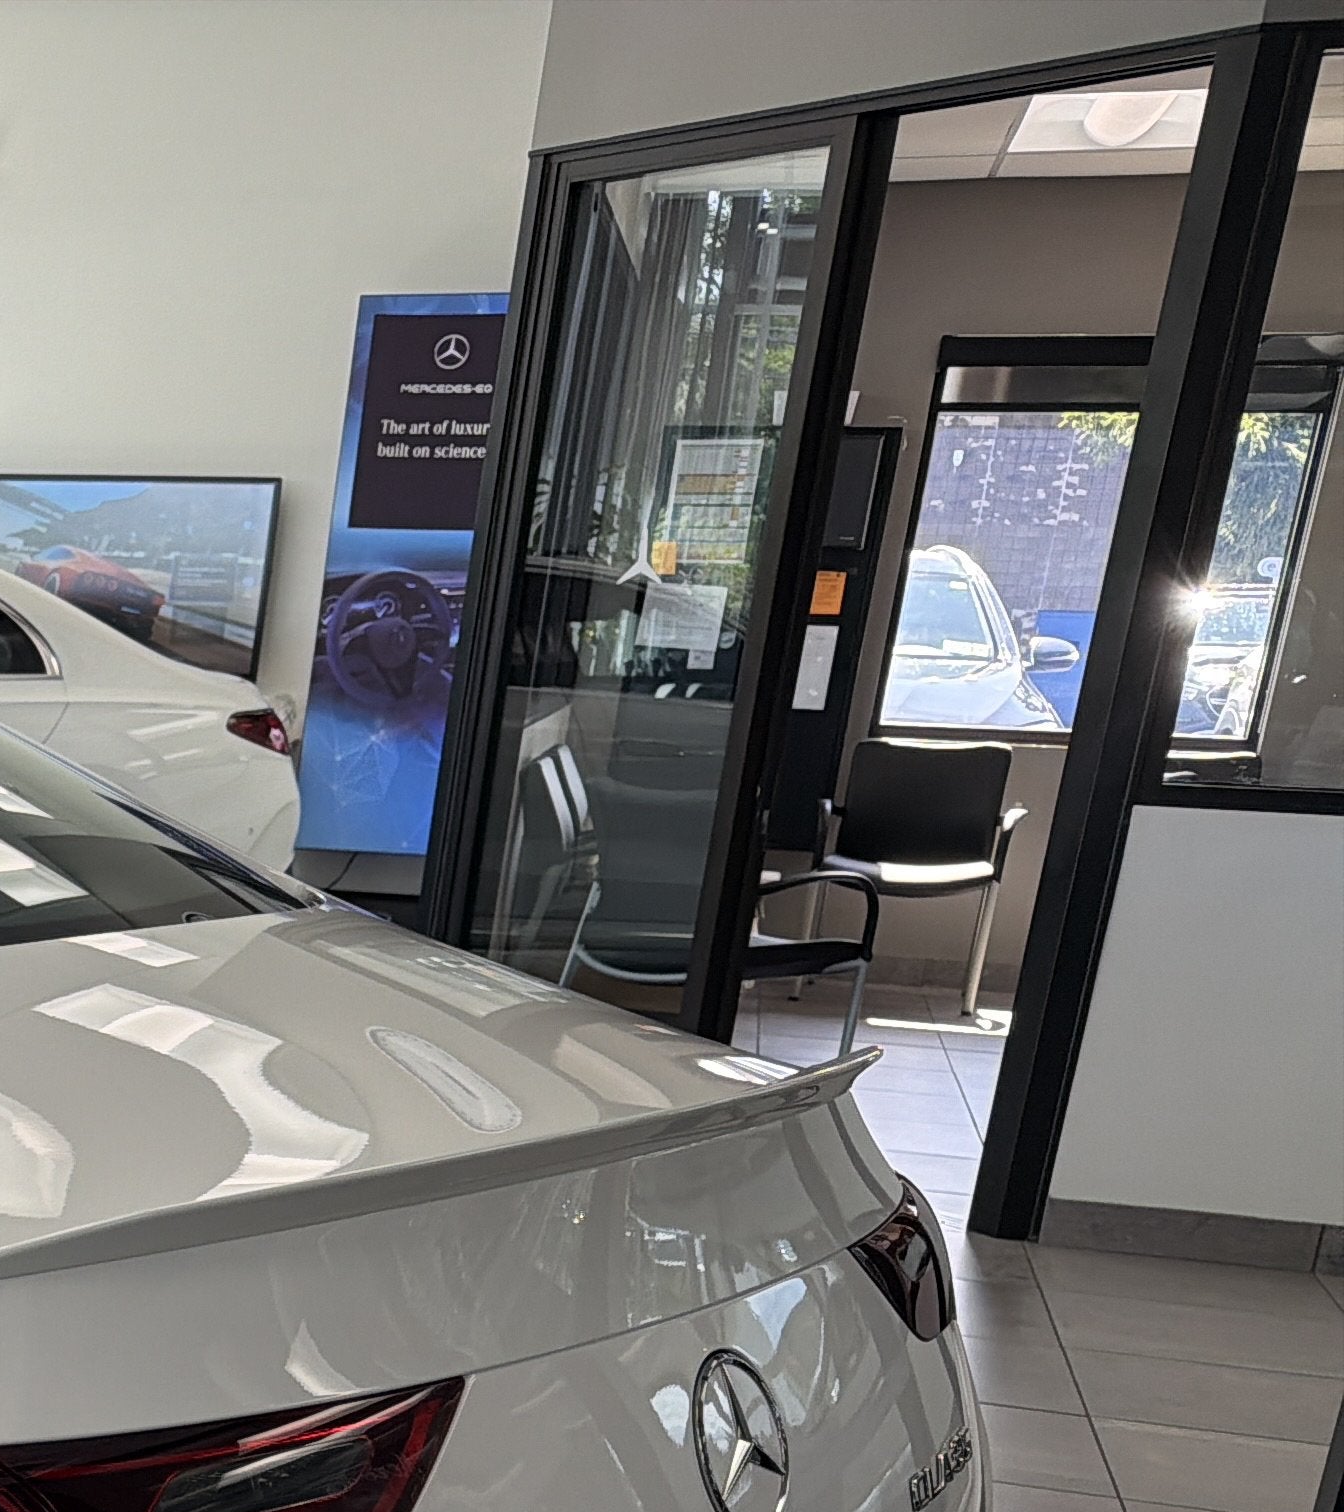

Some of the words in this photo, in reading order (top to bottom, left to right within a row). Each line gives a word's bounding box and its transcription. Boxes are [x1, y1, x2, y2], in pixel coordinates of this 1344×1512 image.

[380, 418, 407, 435] The
[408, 421, 431, 436] art
[432, 419, 450, 436] of
[451, 419, 491, 436] luxur
[376, 441, 411, 458] built
[412, 445, 431, 459] on
[433, 443, 487, 459] science
